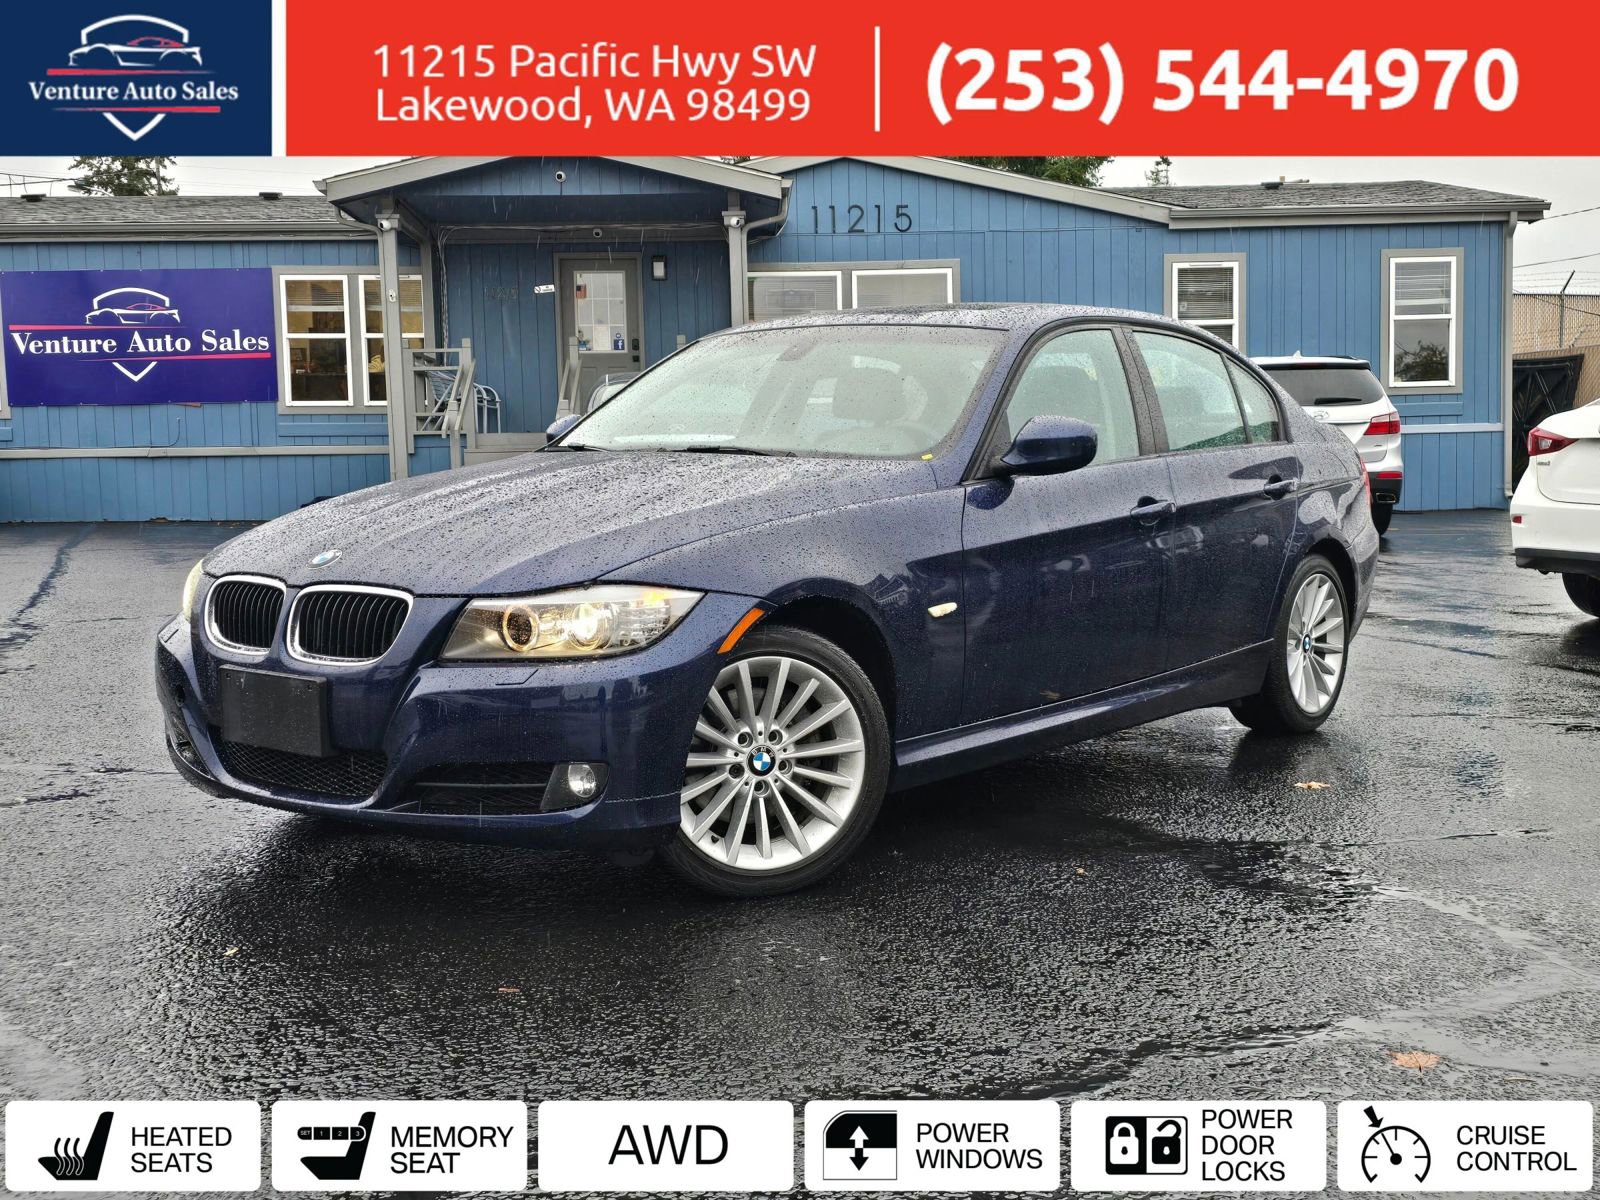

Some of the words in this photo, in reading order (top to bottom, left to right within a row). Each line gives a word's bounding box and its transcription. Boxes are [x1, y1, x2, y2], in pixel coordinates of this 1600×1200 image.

[811, 204, 913, 234] 11215
[10, 332, 117, 355] Venture
[127, 330, 192, 353] Auto
[201, 328, 270, 352] Sales
